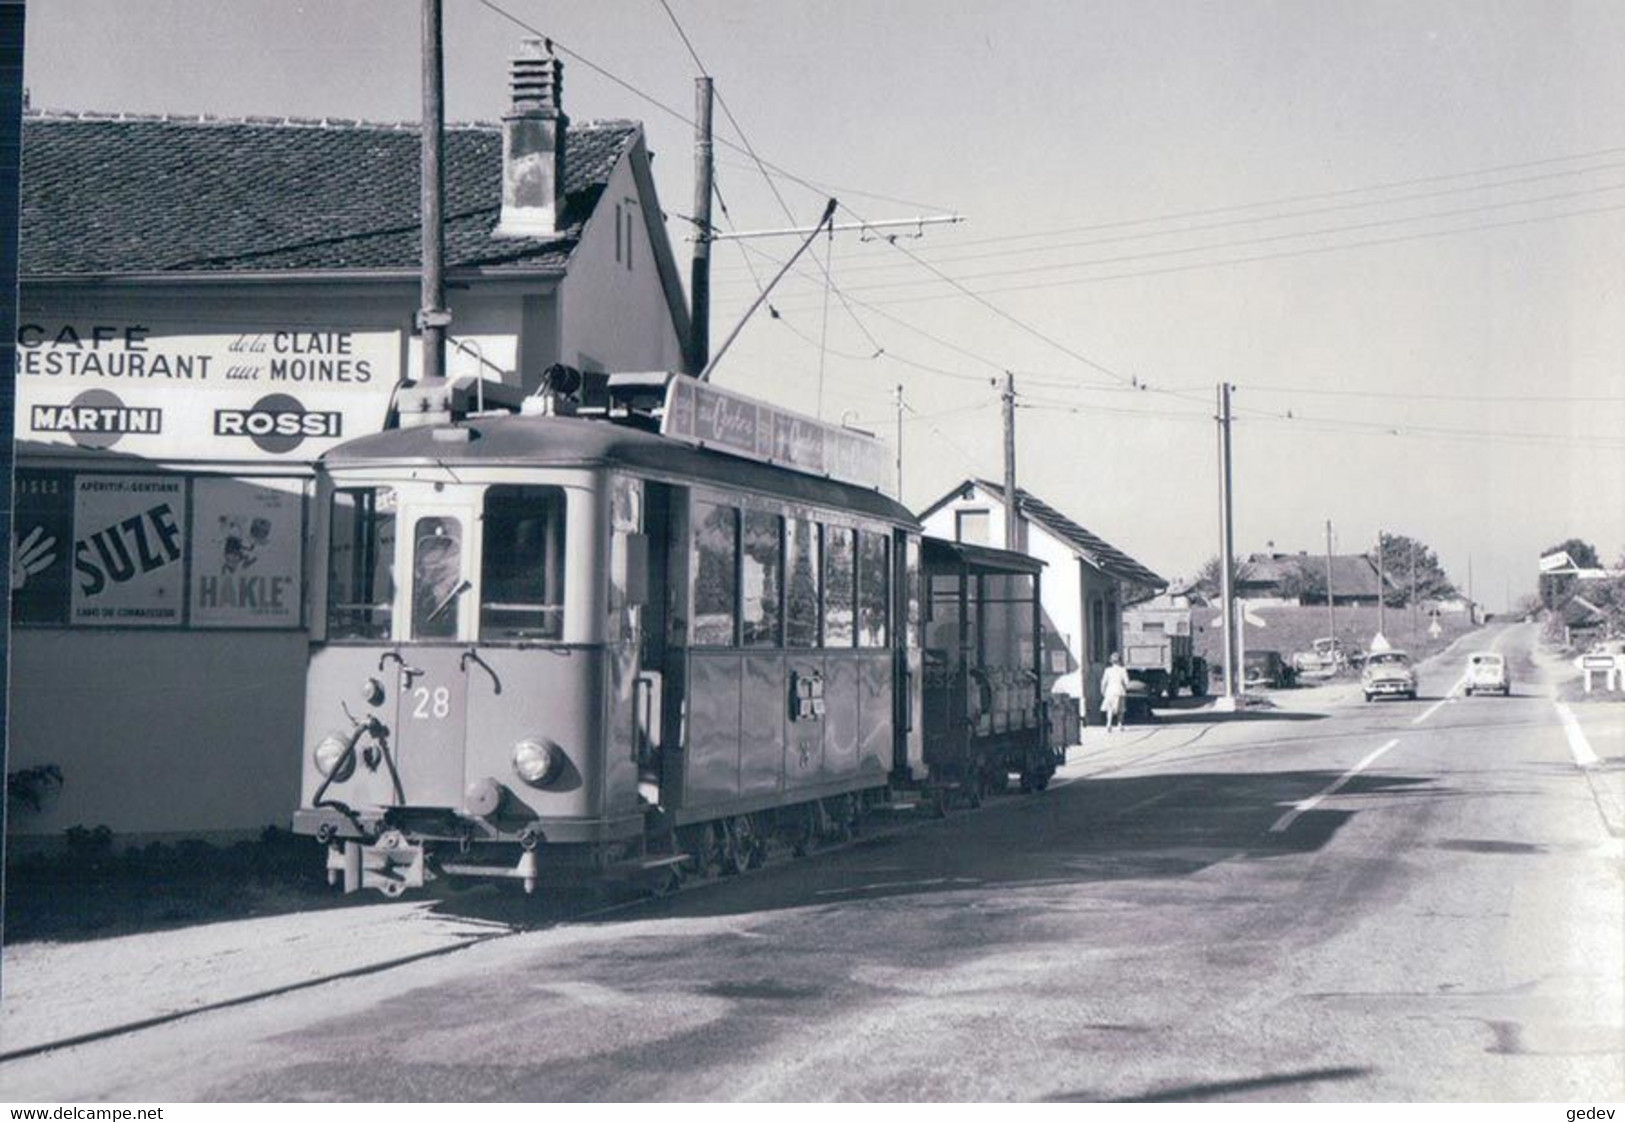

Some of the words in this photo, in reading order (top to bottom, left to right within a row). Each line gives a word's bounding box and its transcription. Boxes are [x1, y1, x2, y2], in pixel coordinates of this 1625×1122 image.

[17, 323, 151, 352] CAFÉ
[273, 331, 353, 355] CLAIE
[225, 365, 264, 381] aux
[270, 359, 372, 383] MOINES
[33, 407, 161, 433] MARTINI
[218, 412, 339, 436] ROSSI
[75, 502, 181, 597] SUZE
[413, 686, 450, 718] 28
